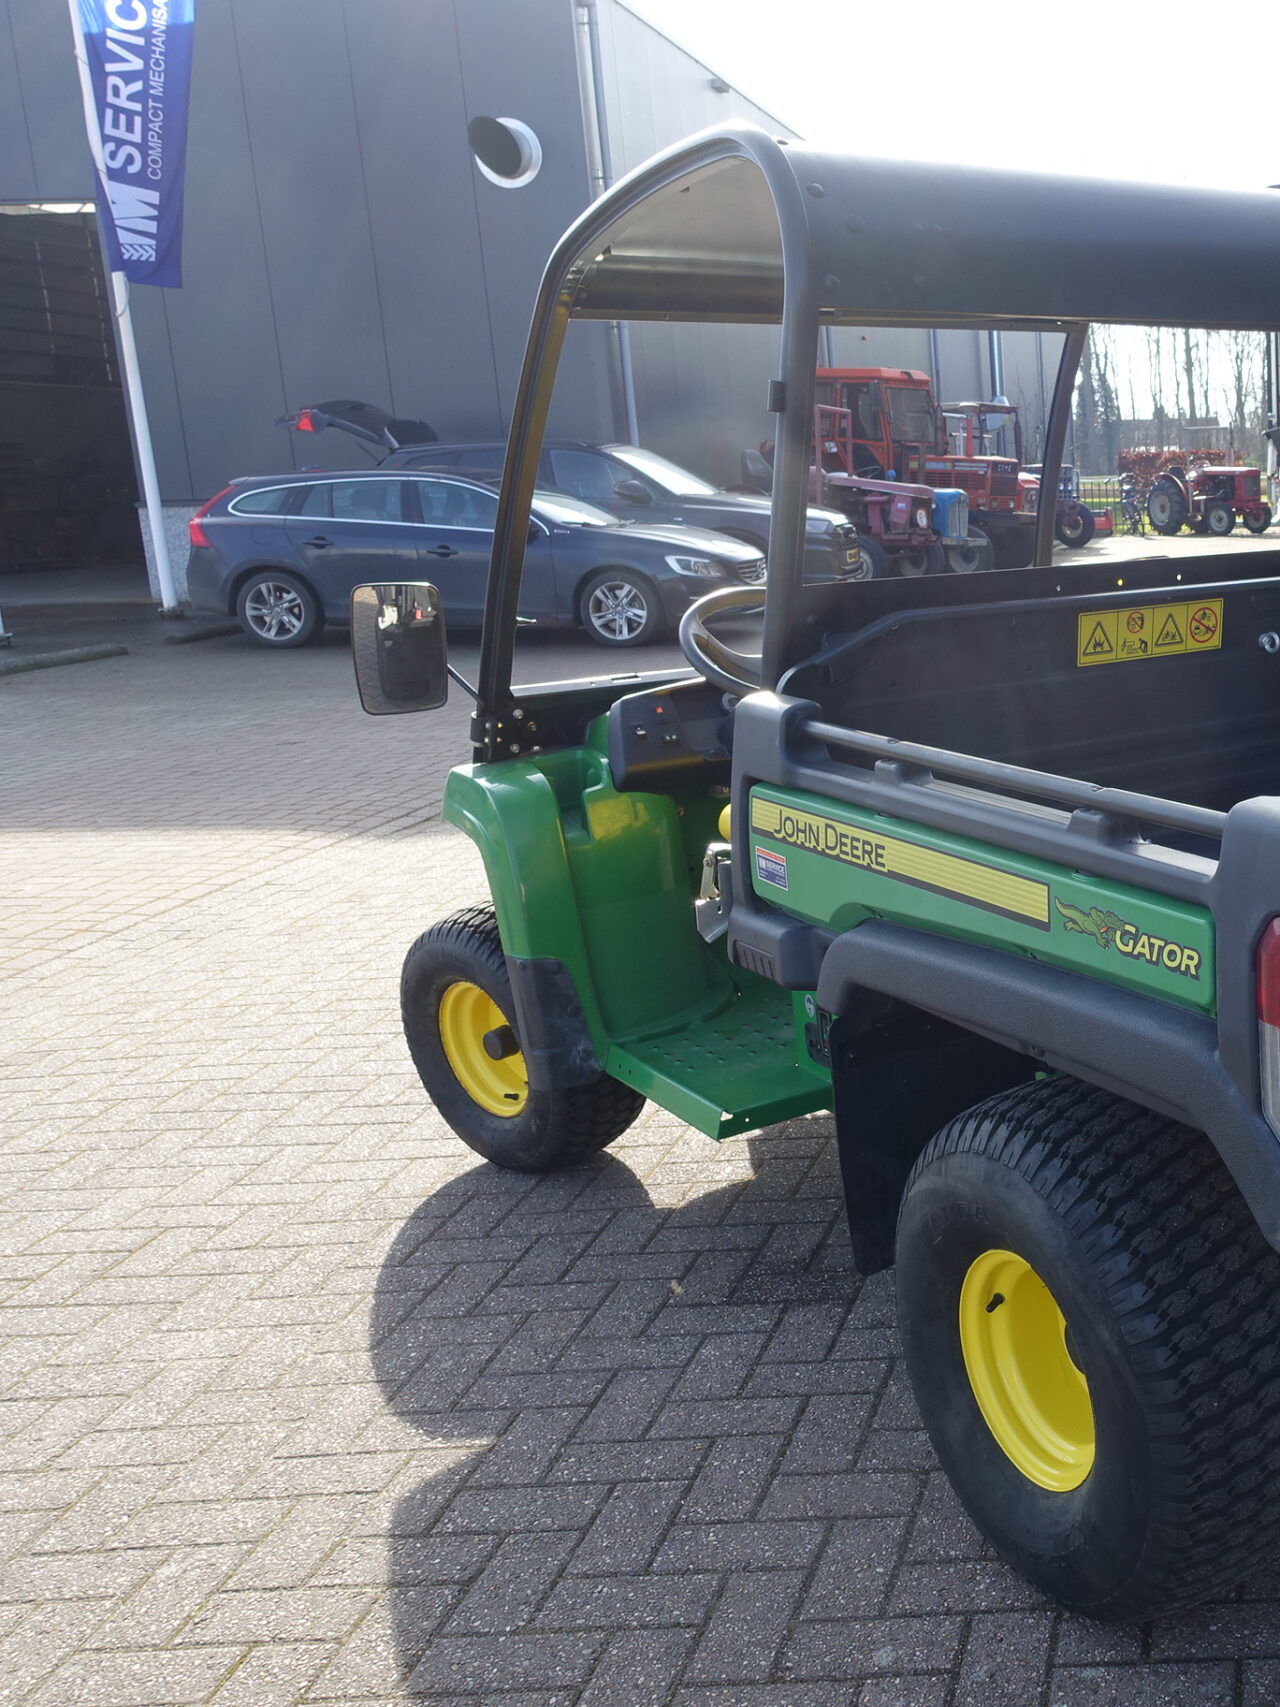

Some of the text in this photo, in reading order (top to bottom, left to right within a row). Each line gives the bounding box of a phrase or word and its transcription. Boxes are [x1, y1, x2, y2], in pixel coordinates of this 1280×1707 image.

[103, 0, 147, 174] SERVIC
[147, 98, 164, 180] COMPACT
[773, 808, 887, 869] JOHN DEERE
[1114, 923, 1200, 978] GATOR
